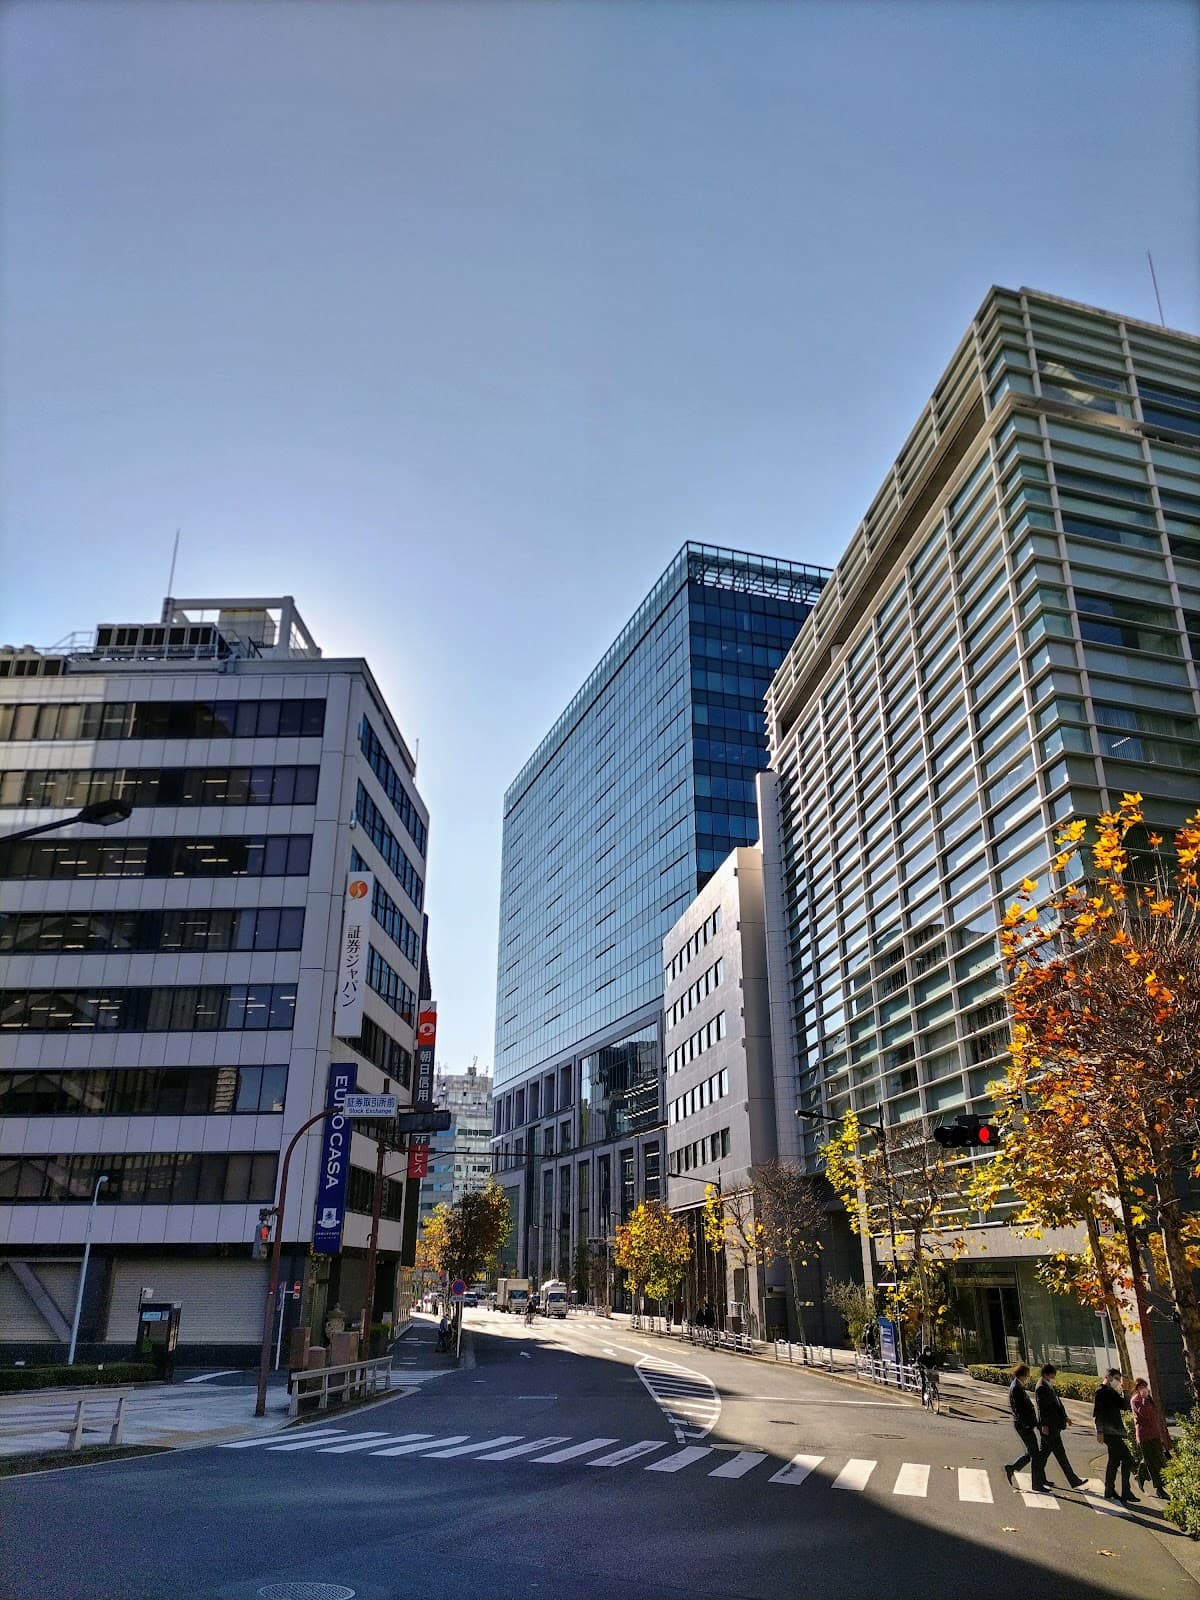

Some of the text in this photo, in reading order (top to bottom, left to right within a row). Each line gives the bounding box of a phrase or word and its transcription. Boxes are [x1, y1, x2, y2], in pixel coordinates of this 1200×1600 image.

[343, 925, 361, 1007] 証券ジャパン
[347, 1097, 394, 1108] 証券取引所前
[415, 1136, 427, 1144] 7F
